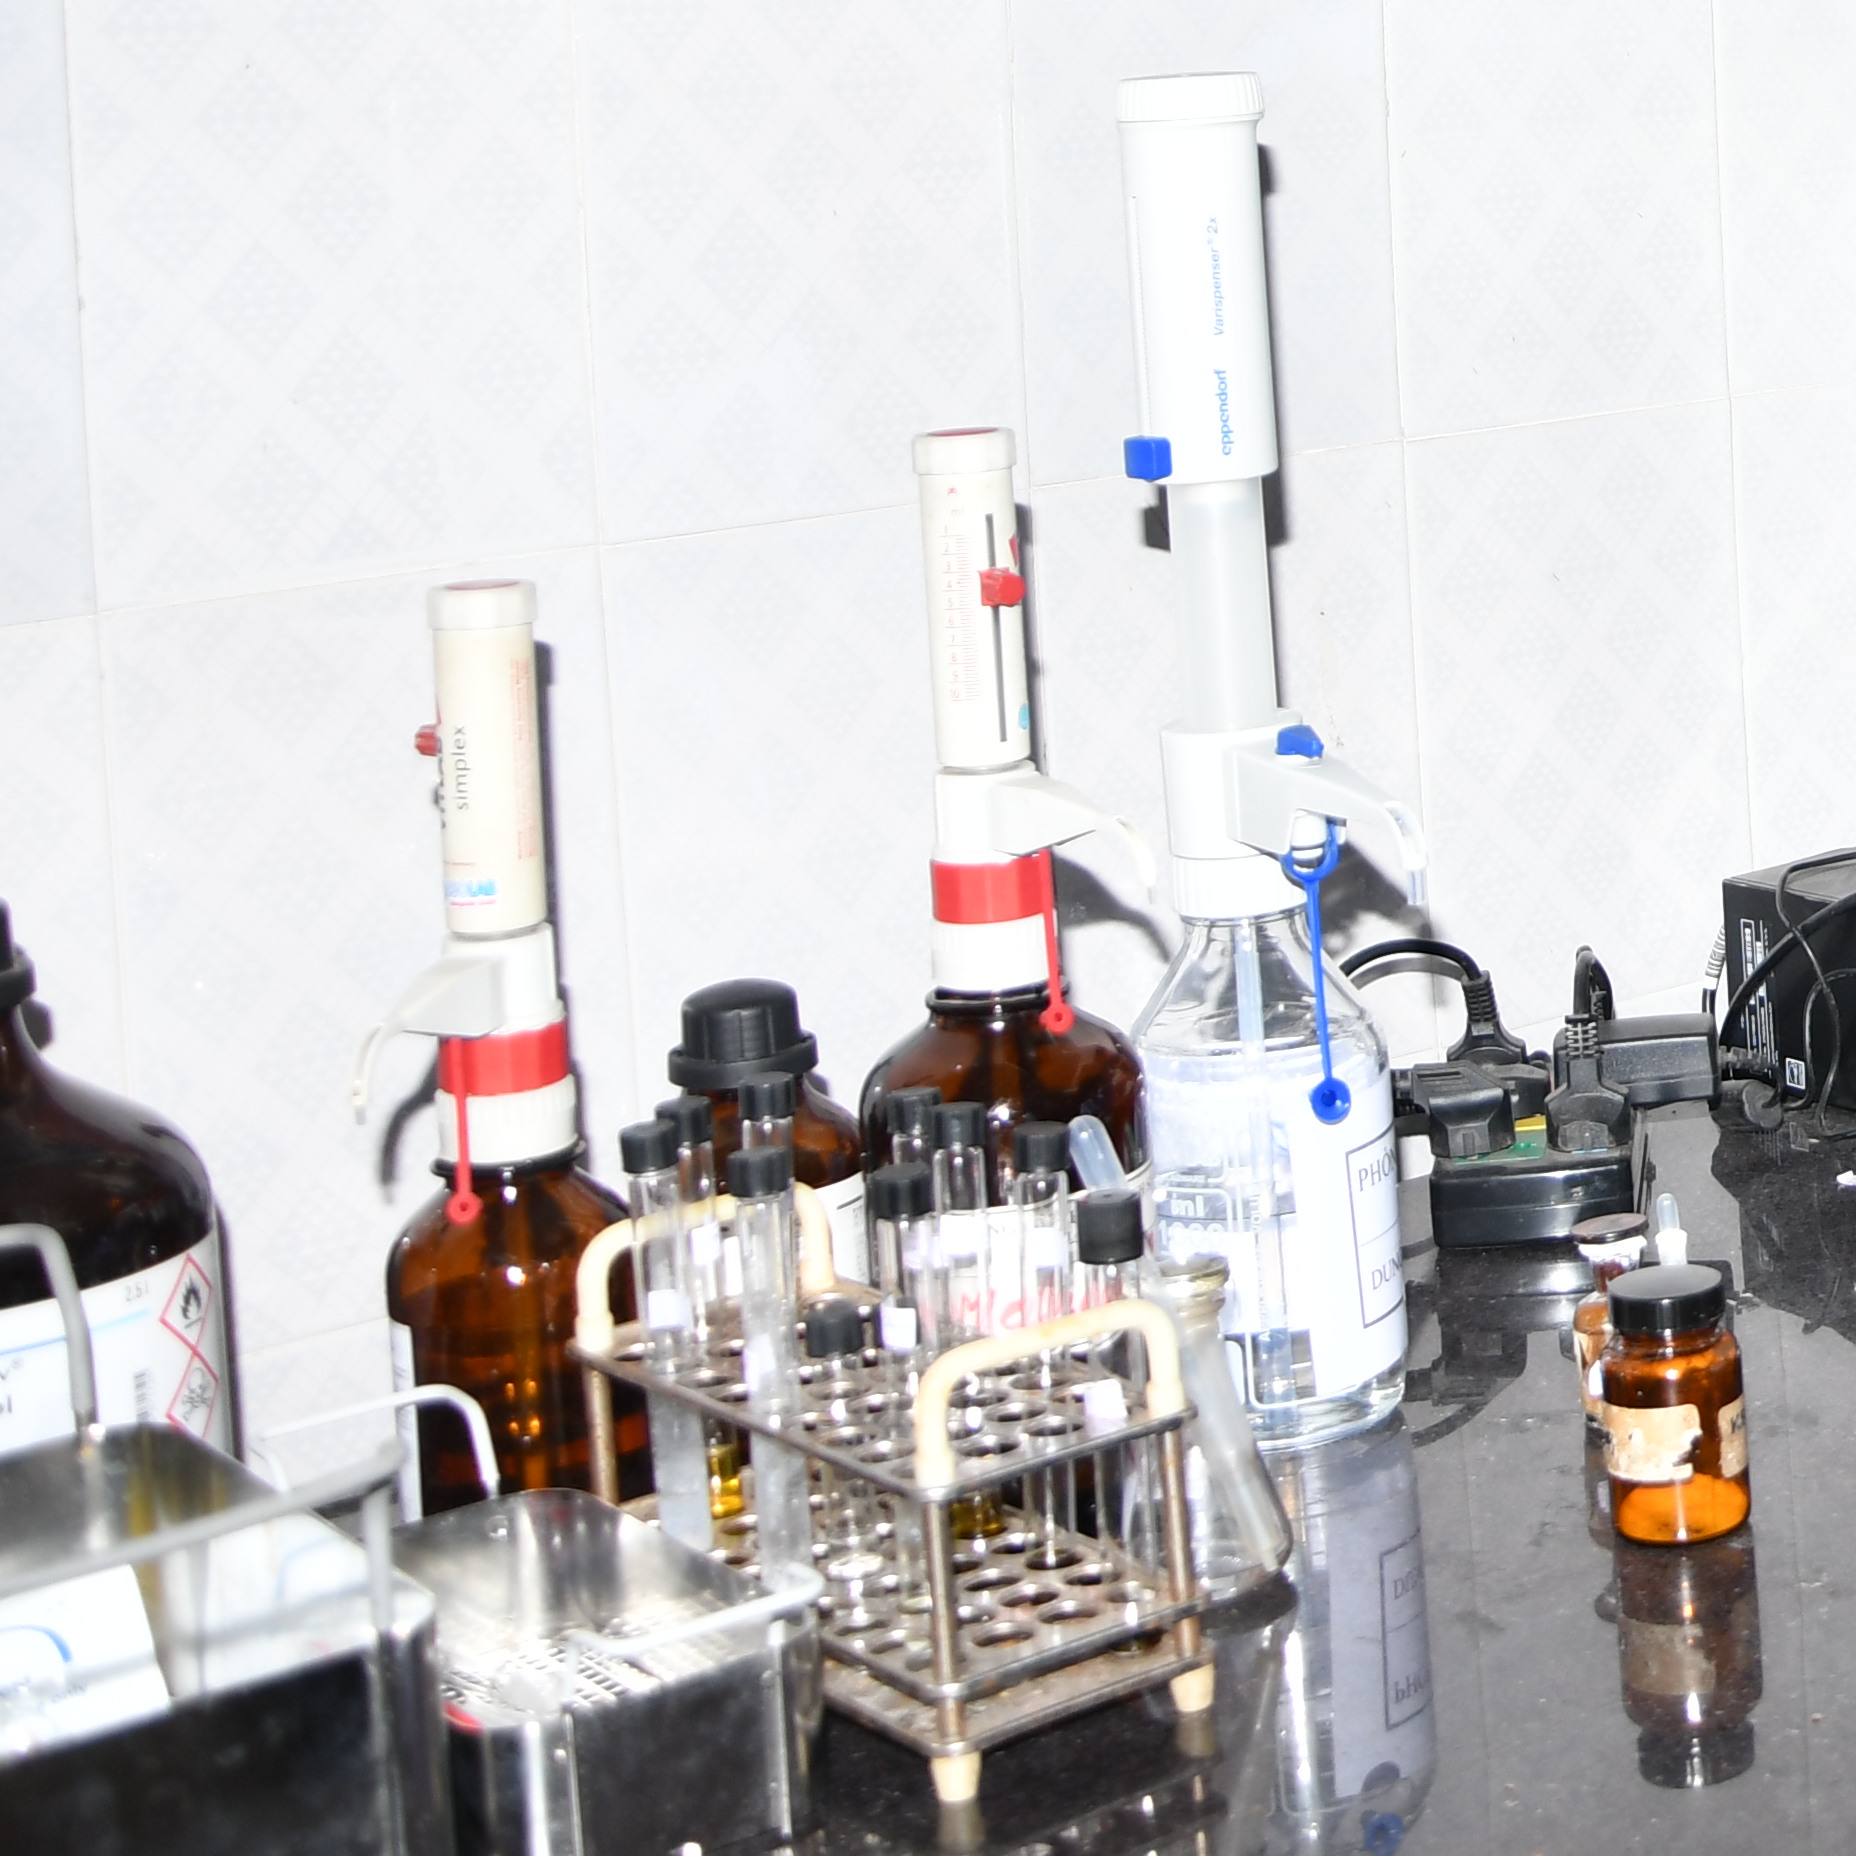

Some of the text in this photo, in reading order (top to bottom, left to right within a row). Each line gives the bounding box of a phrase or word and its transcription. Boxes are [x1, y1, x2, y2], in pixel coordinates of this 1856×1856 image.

[1206, 216, 1218, 234] 2x
[1213, 368, 1234, 456] eppendorf
[451, 725, 471, 811] simplex
